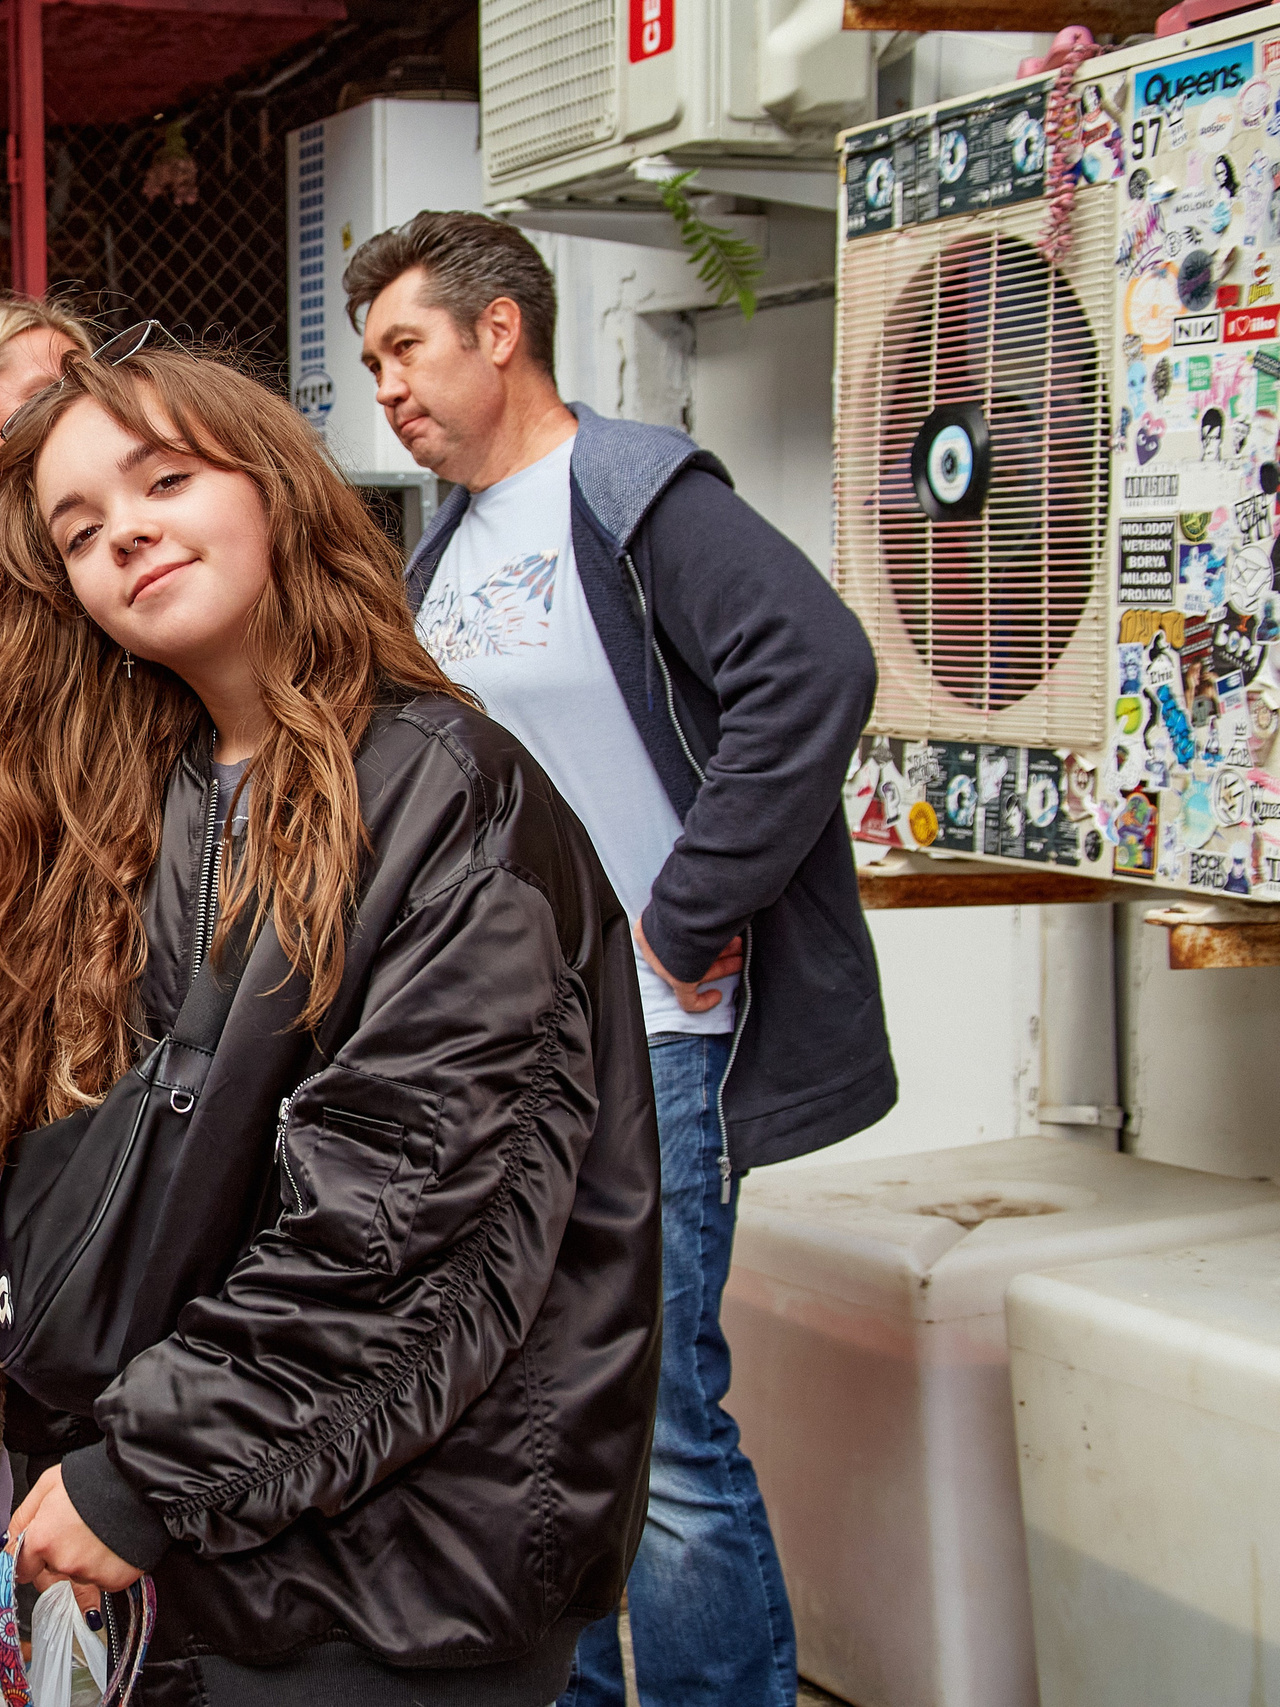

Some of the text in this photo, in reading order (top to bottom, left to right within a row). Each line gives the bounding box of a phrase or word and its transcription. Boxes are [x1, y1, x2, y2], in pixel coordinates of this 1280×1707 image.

[1132, 117, 1162, 161] 97
[1175, 199, 1215, 214] MOLOKO
[1126, 475, 1178, 498] ADVISORY
[1121, 521, 1174, 537] MOLODOY
[1123, 538, 1173, 553] VETEROK
[1127, 555, 1167, 569] BORYA
[1121, 571, 1172, 585] MILORAD
[1120, 588, 1173, 601] PROLIVKA
[1190, 869, 1225, 888] BAND
